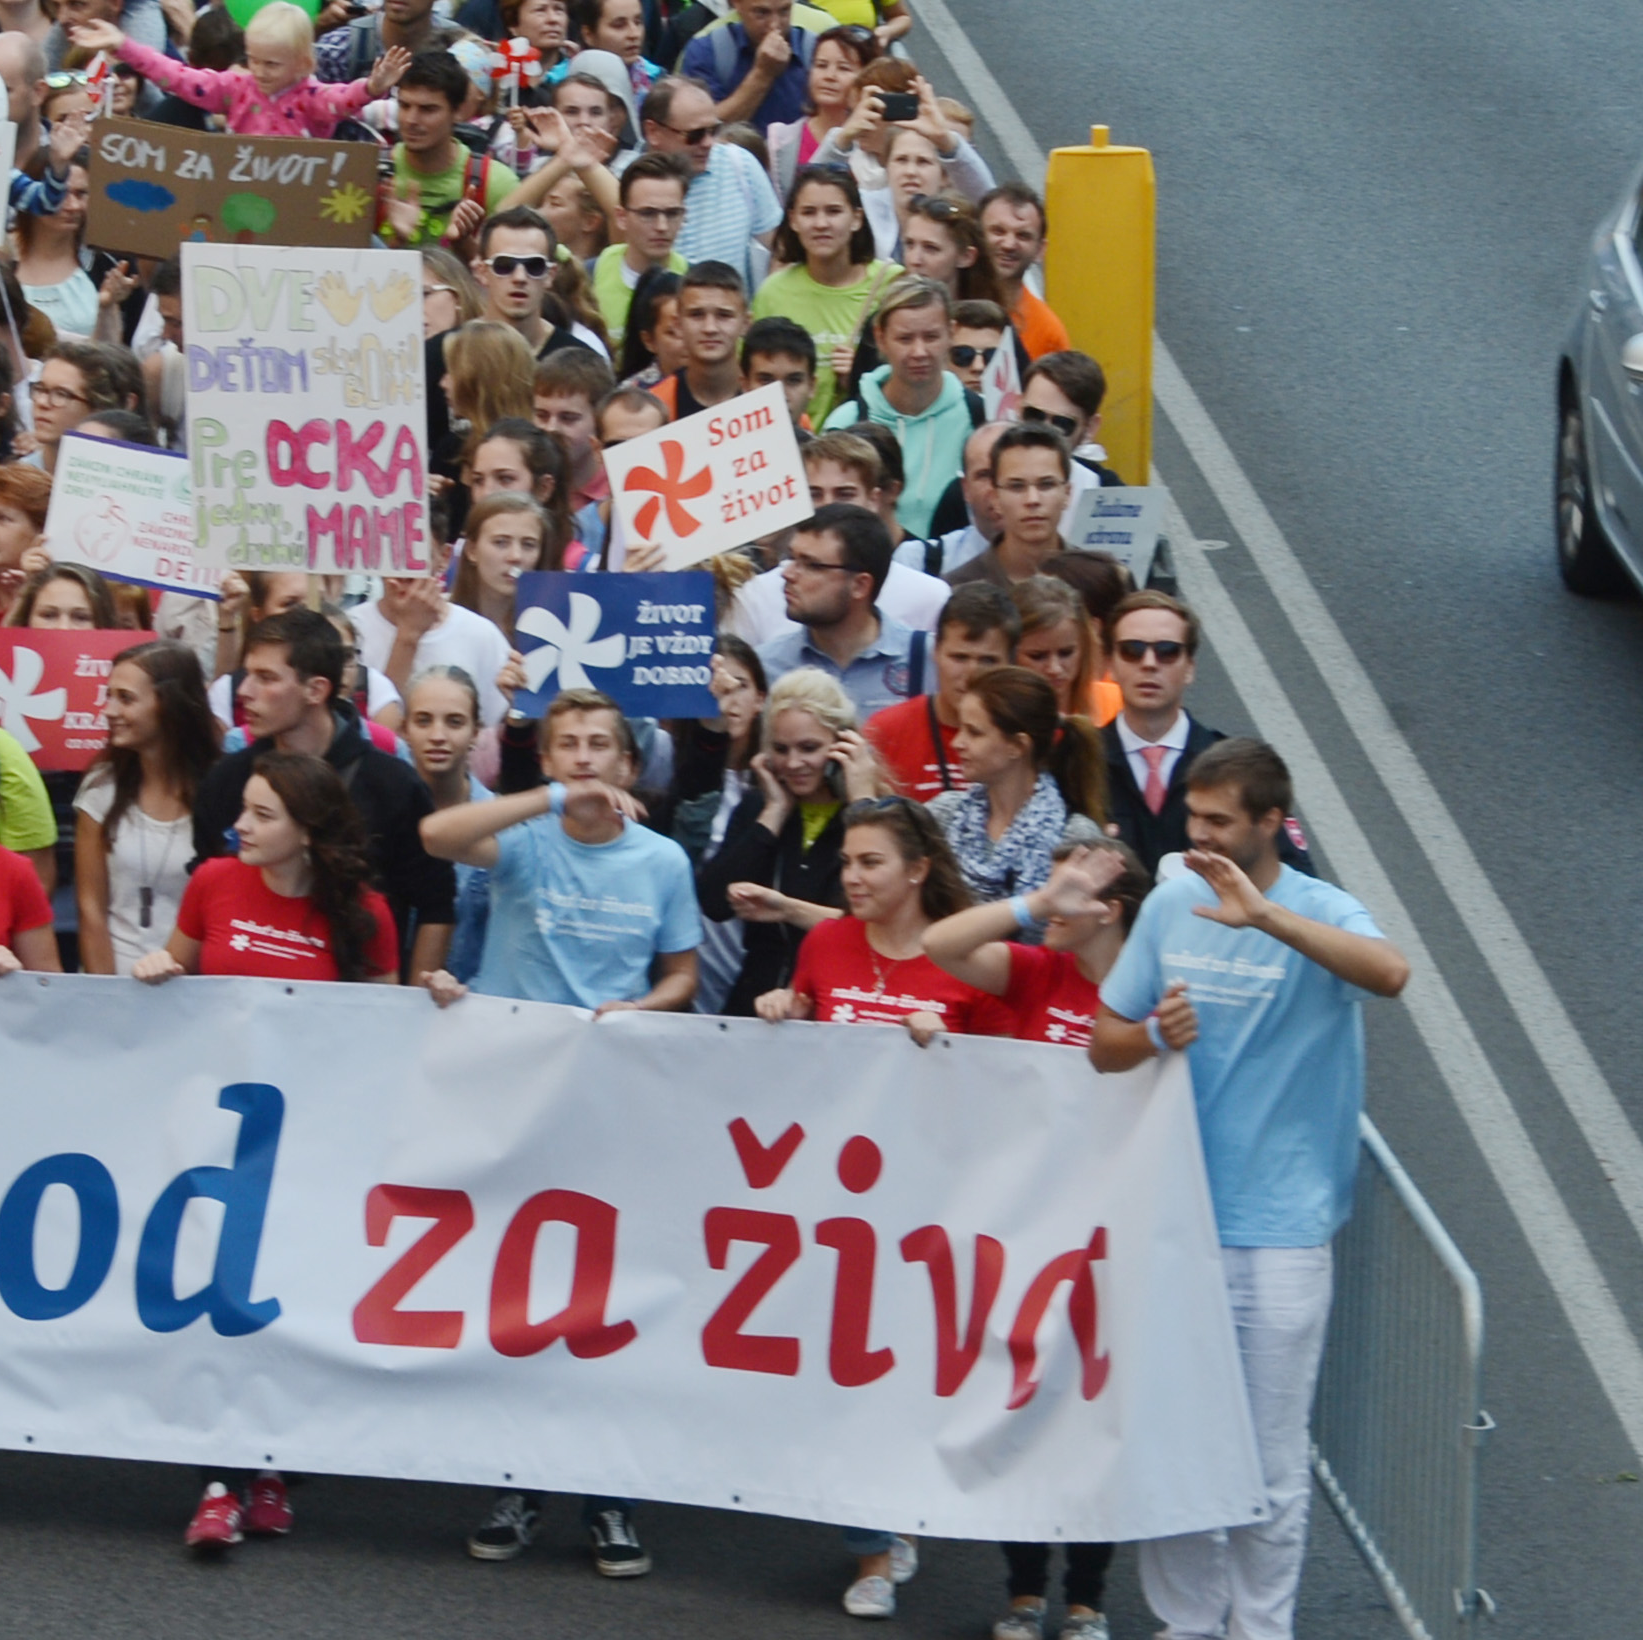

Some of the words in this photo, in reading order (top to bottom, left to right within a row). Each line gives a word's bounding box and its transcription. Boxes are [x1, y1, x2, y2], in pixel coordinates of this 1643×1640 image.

[99, 132, 166, 170] SOM
[175, 148, 215, 180] ZA
[192, 265, 315, 334] DVE
[187, 337, 311, 394] DEŤOM
[708, 403, 775, 447] Som
[190, 416, 259, 491] Pre
[265, 417, 426, 502] OCKA
[732, 448, 769, 479] za
[721, 474, 797, 525] život
[304, 501, 427, 571] MAME
[635, 599, 707, 624] ŽIVOT
[73, 654, 114, 677] ŽIV
[626, 635, 653, 659] JE
[655, 630, 715, 655] VŽDY
[632, 665, 713, 686] DOBRO
[354, 1183, 637, 1359] za
